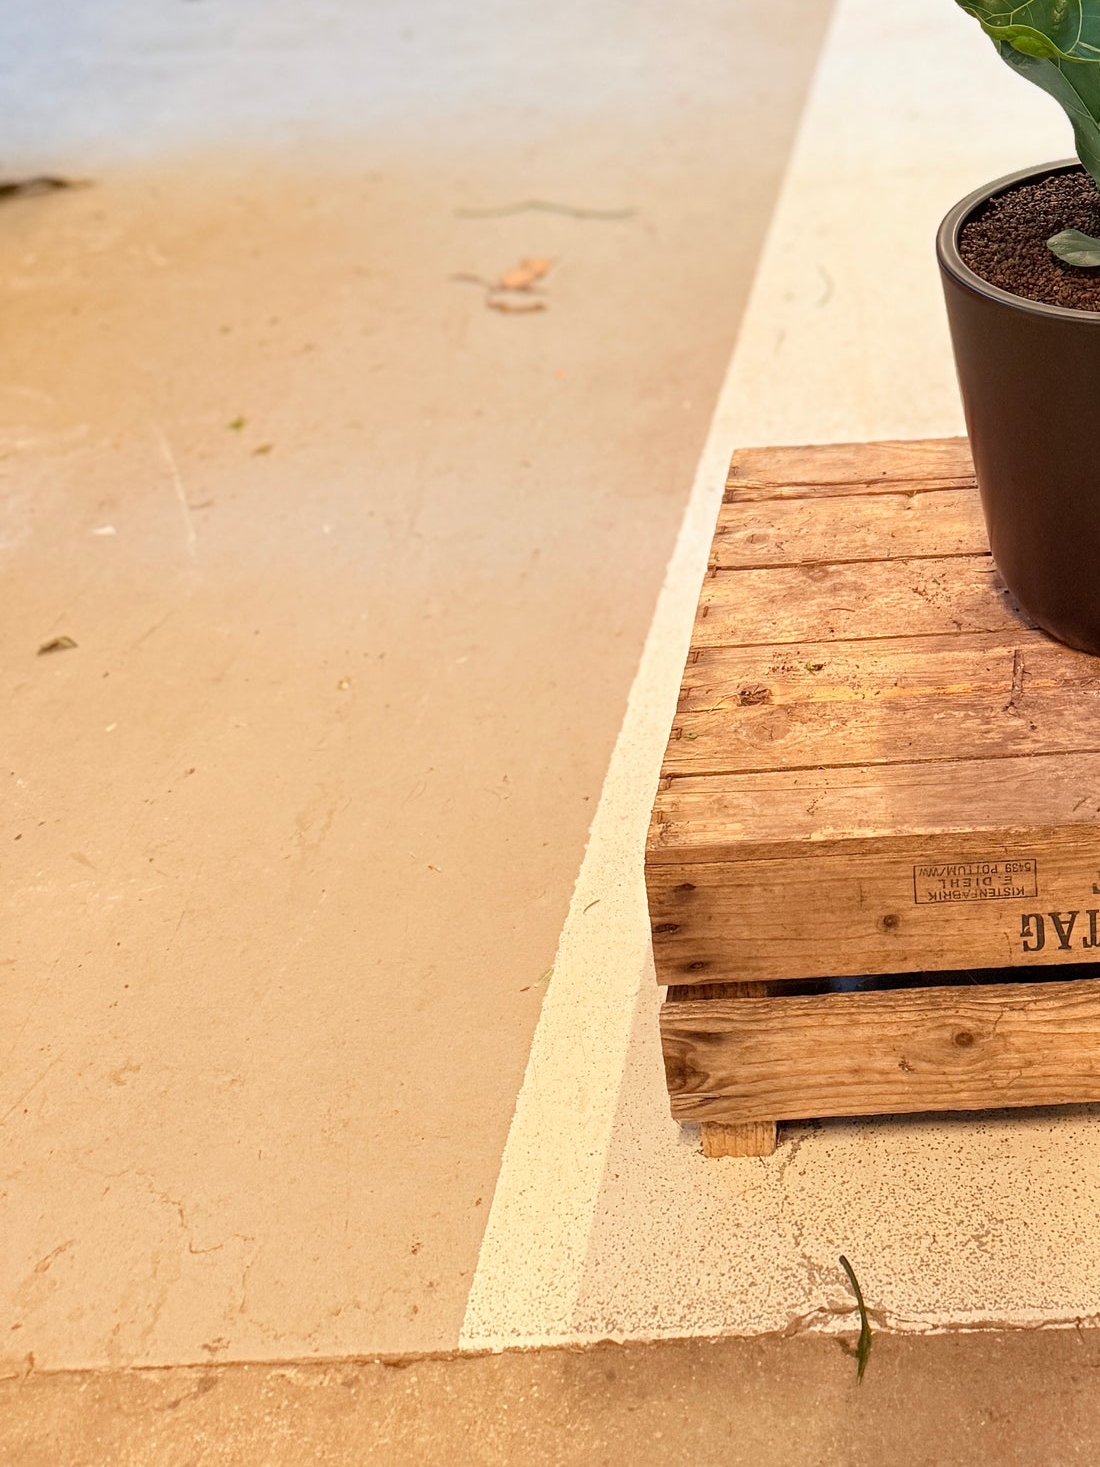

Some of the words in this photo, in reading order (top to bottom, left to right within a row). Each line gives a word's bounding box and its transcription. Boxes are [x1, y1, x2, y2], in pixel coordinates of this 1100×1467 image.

[1004, 862, 1031, 873] 5439
[938, 876, 992, 889] DIEHL
[928, 886, 1025, 901] KISTENFABRIK
